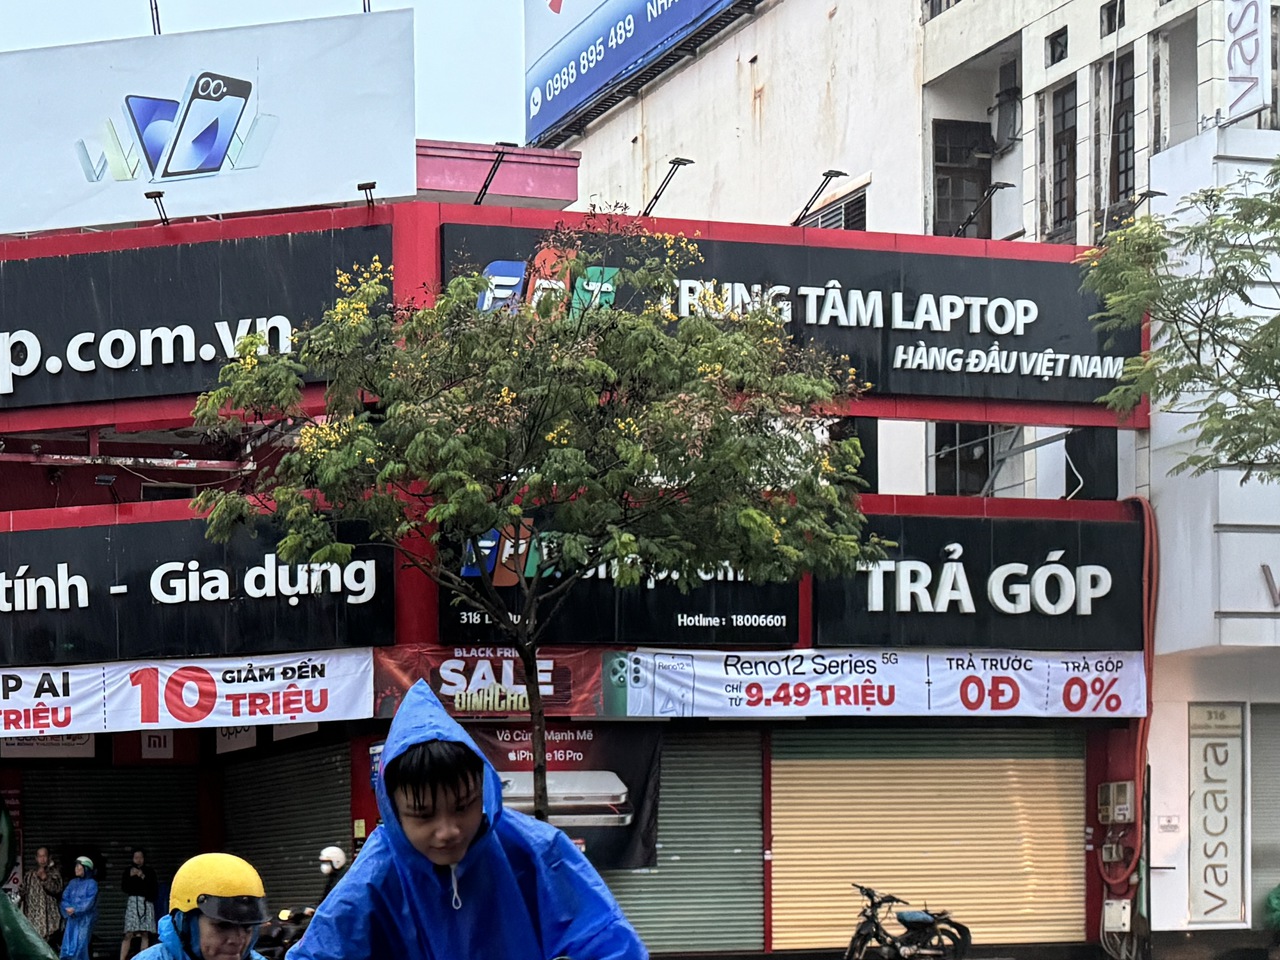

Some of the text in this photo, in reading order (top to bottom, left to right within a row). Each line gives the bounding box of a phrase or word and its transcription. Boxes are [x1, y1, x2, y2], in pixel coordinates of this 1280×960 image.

[546, 64, 577, 102] 0988
[580, 37, 604, 74] 895
[608, 14, 634, 50] 489
[798, 279, 884, 329] TÂM
[892, 291, 1038, 336] LAPTOP
[892, 341, 1124, 382] HÀNG ĐẦU VIỆT NAM
[150, 560, 230, 604] Gia
[244, 553, 376, 606] dụng
[856, 542, 976, 614] TRẢ
[987, 550, 1112, 616] GÓP
[460, 612, 481, 624] 318
[731, 614, 786, 627] 18006601
[454, 648, 494, 658] BLACK
[724, 653, 898, 676] Reno12 Series 5G
[946, 653, 1032, 671] TRẢ TRƯỚC
[1062, 656, 1124, 672] TRẢ GÓP
[34, 672, 70, 698] AI
[222, 658, 326, 684] GIẢM ĐẾN
[439, 659, 554, 696] SALE
[129, 666, 218, 724] 10
[226, 684, 328, 720] TRIỆU
[745, 682, 810, 707] 9.49
[816, 678, 896, 711] TRIỆU
[1062, 676, 1122, 712] 0%
[496, 730, 511, 740] Vô
[544, 730, 574, 742] Mạnh
[517, 750, 584, 760] iPhe 16 Pro
[1203, 742, 1228, 916] vascara
